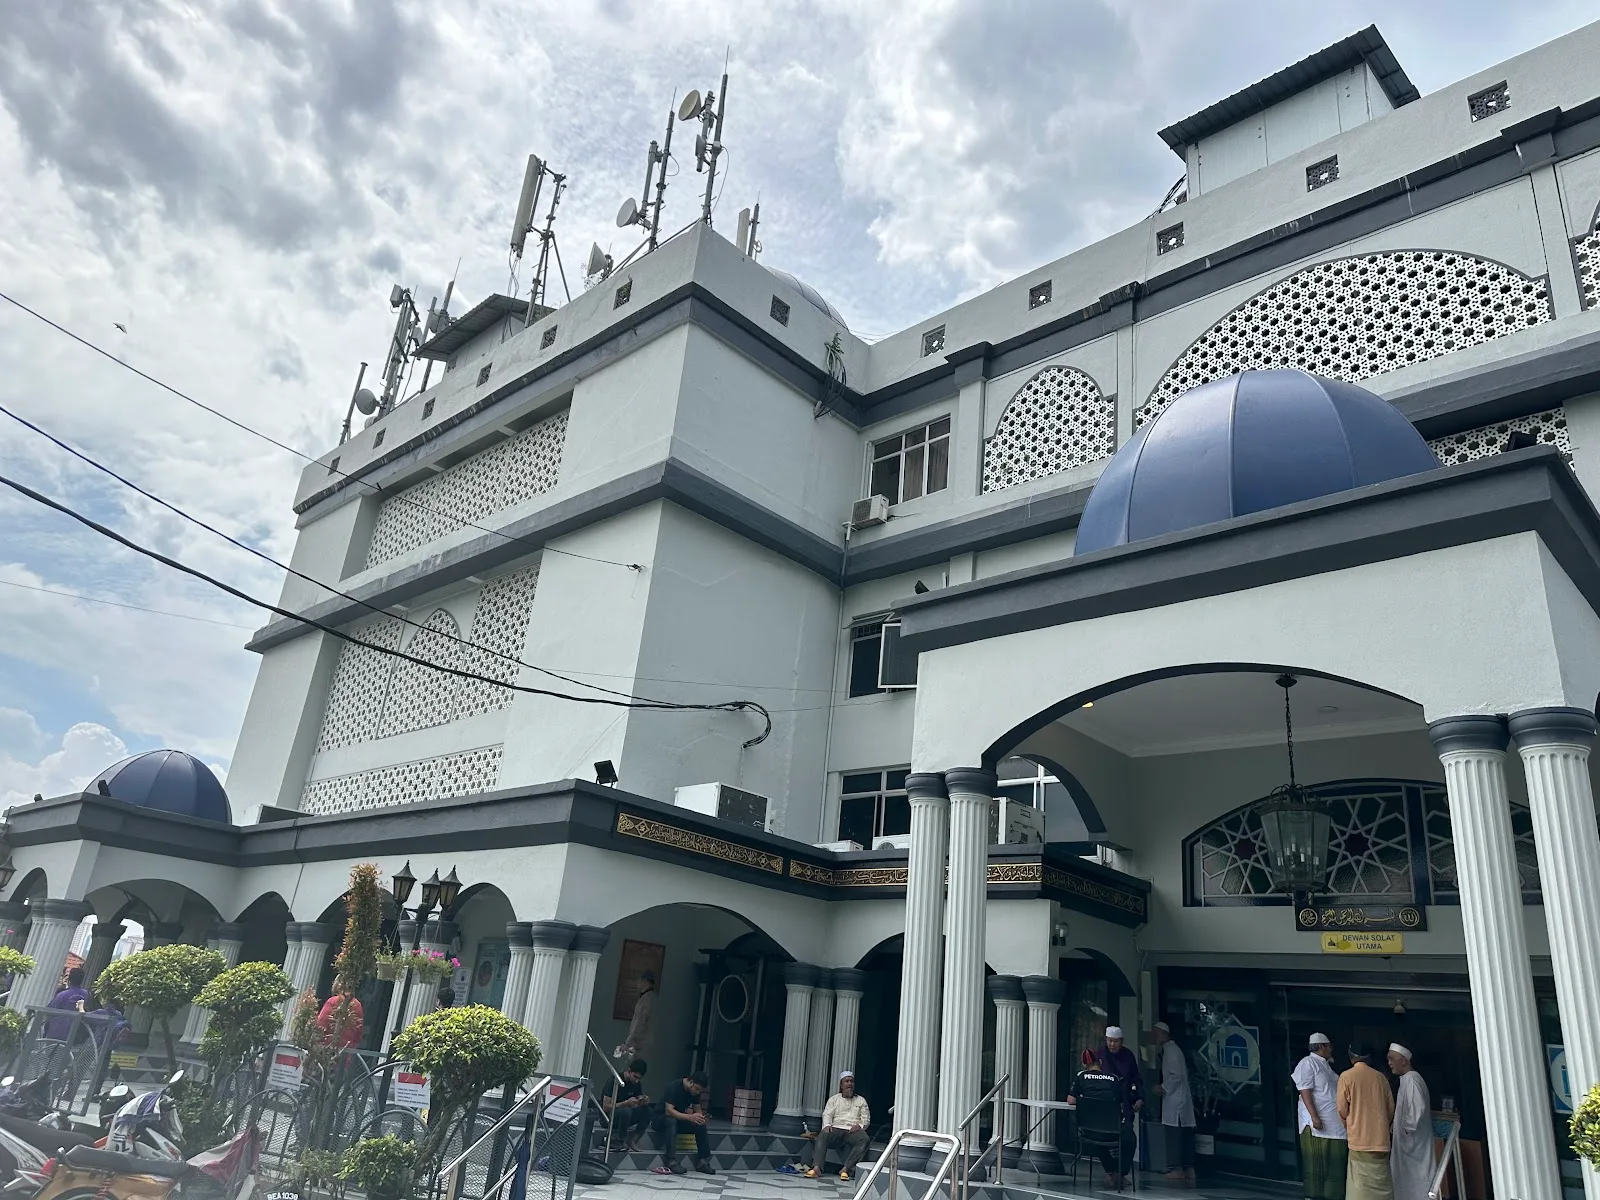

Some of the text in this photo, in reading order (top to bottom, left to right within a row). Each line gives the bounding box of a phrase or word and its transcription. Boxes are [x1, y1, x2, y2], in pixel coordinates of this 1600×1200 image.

[1342, 934, 1396, 942] DEWAN SOLAT
[1083, 1073, 1115, 1082] PETRONAS
